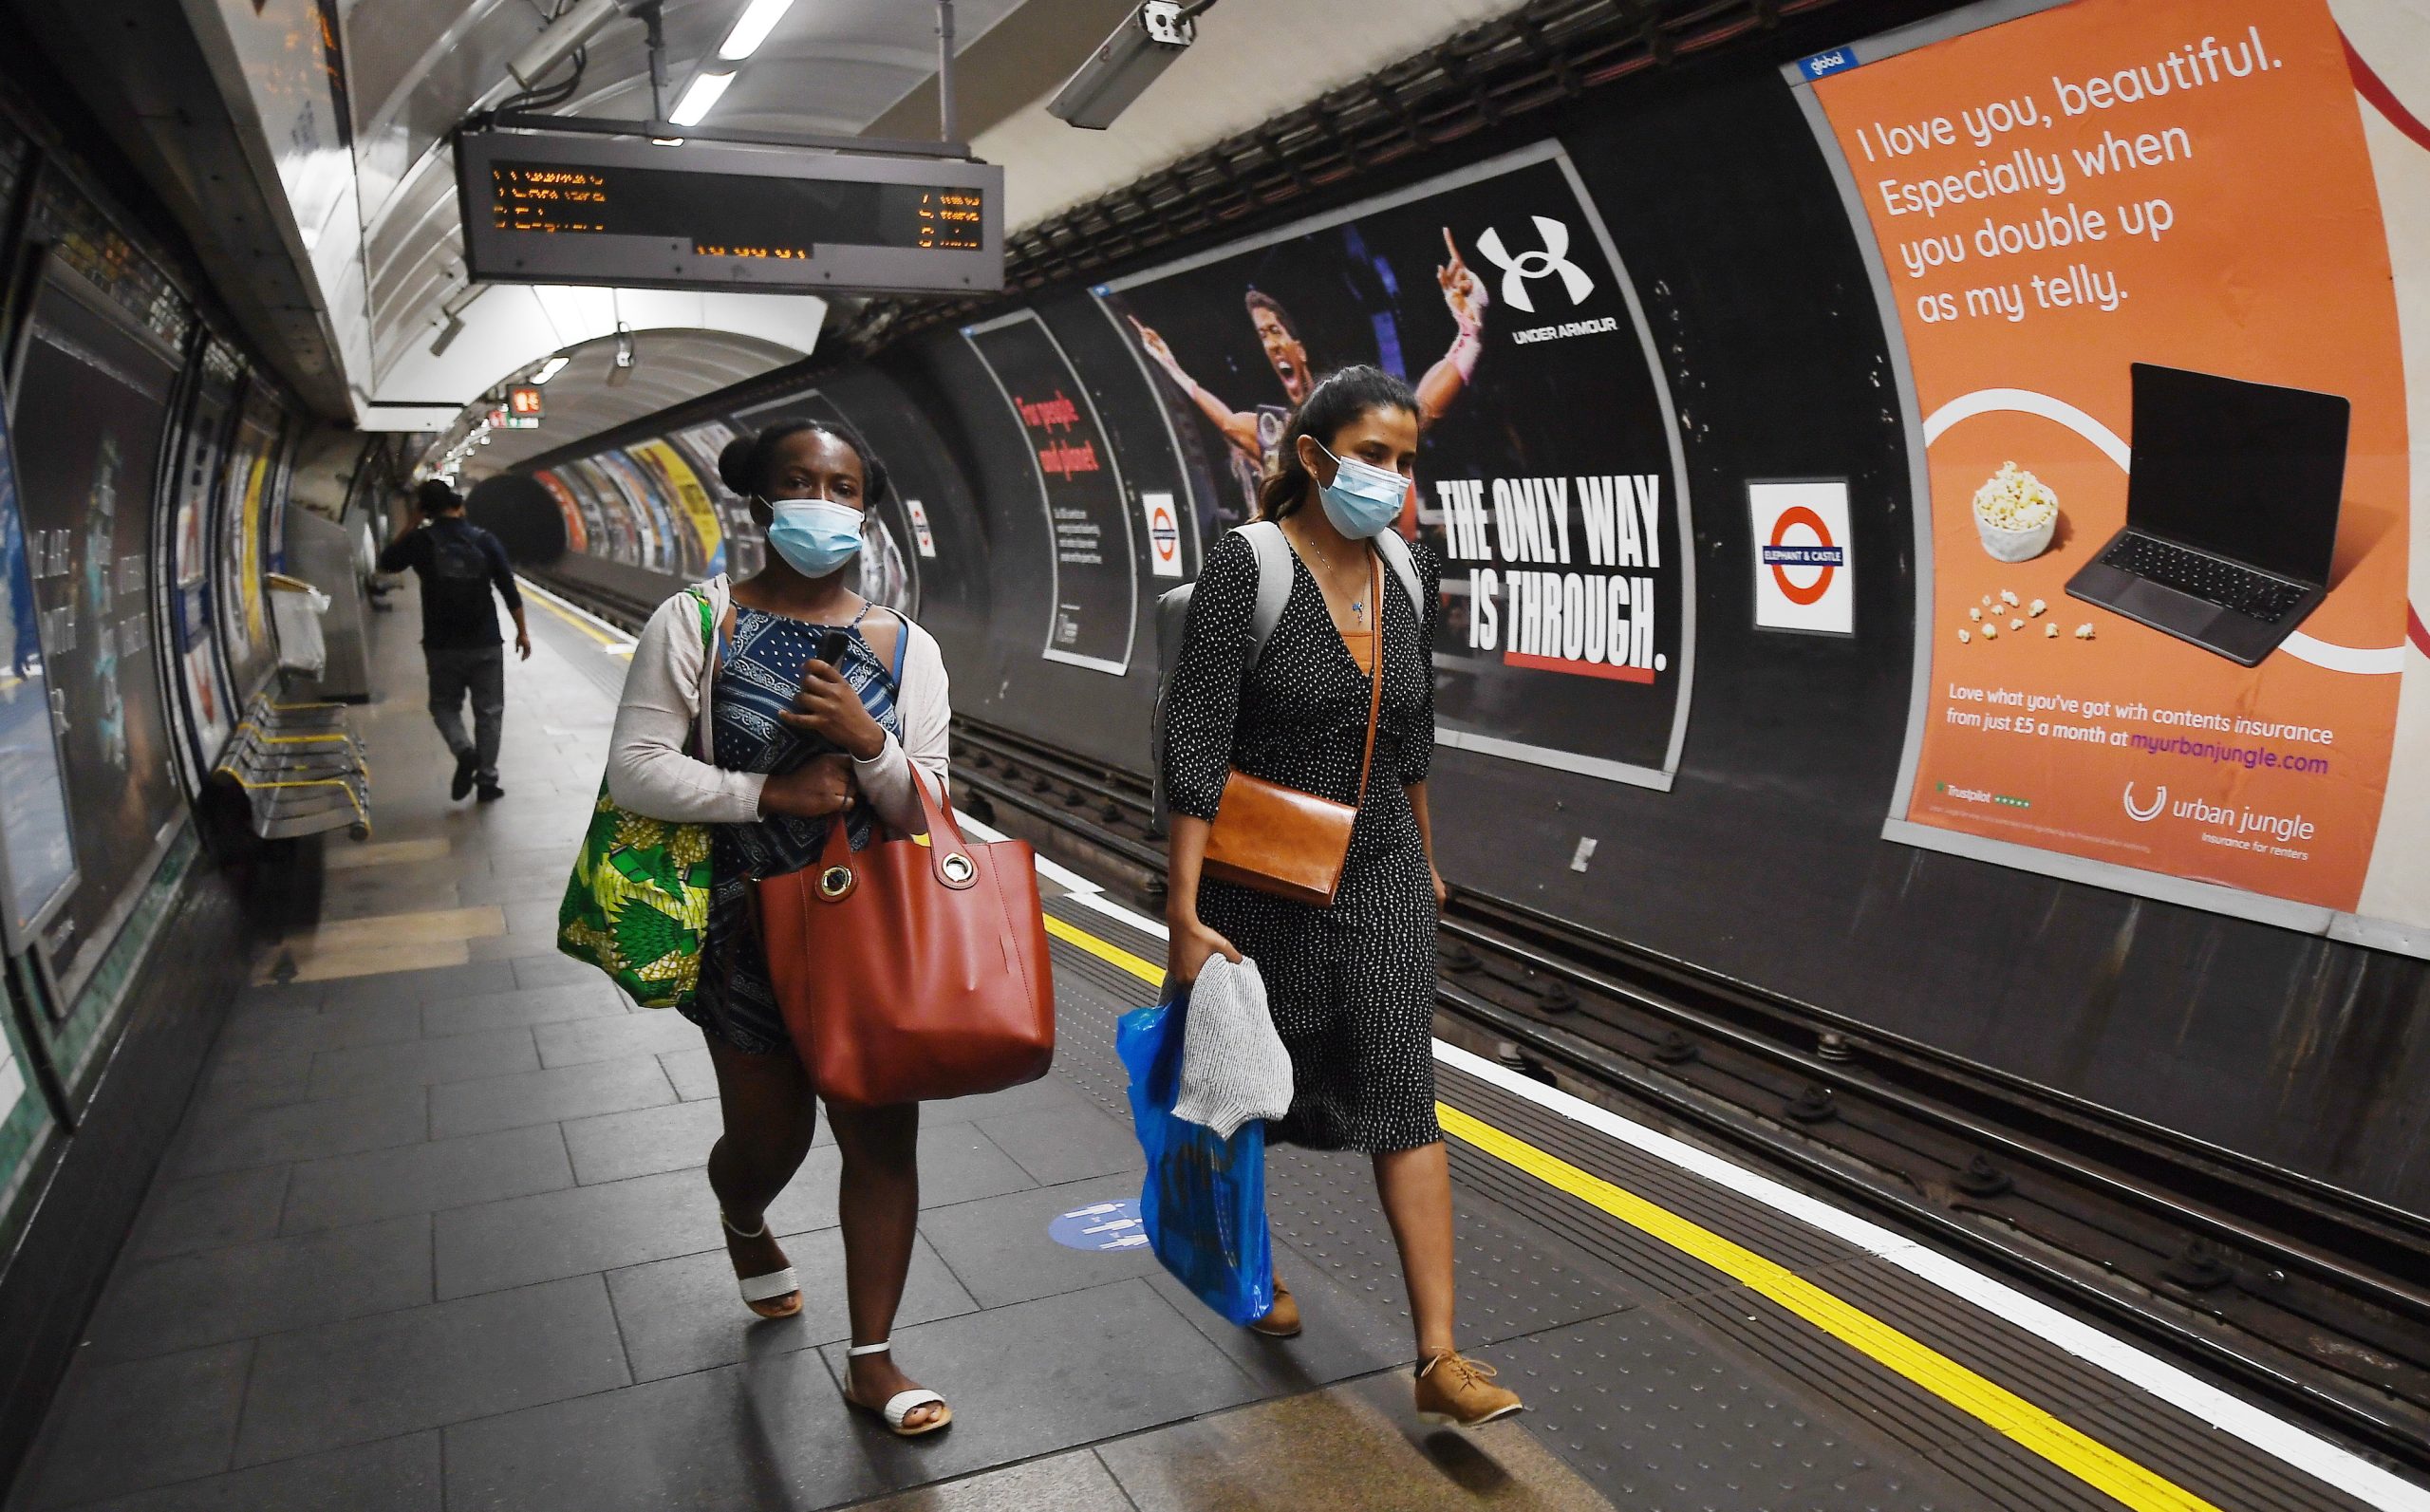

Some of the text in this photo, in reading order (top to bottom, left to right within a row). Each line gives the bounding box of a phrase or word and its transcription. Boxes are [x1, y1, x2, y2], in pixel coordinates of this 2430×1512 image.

[1811, 51, 1845, 76] global
[1857, 26, 2282, 162] I love you, beautiful.
[1879, 127, 2193, 218] Especially when
[1900, 198, 2174, 278] you double up
[1916, 263, 2129, 324] as my telly.
[1511, 316, 1618, 345] UNDER ARMOUR
[1435, 475, 1661, 569] THE ONLY WAY
[1764, 550, 1841, 562] ELEPHANT & CASTLE
[1468, 568, 1668, 672] IS THROUGH.
[1946, 707, 2329, 775] from just £5 a month at myurbanjungle.com
[1949, 682, 2334, 745] Love what you've got with contents insurance
[1948, 784, 1991, 804] Trustpilot
[2172, 798, 2315, 842] urban jungle
[2252, 841, 2270, 853] for
[2270, 844, 2309, 861] renters
